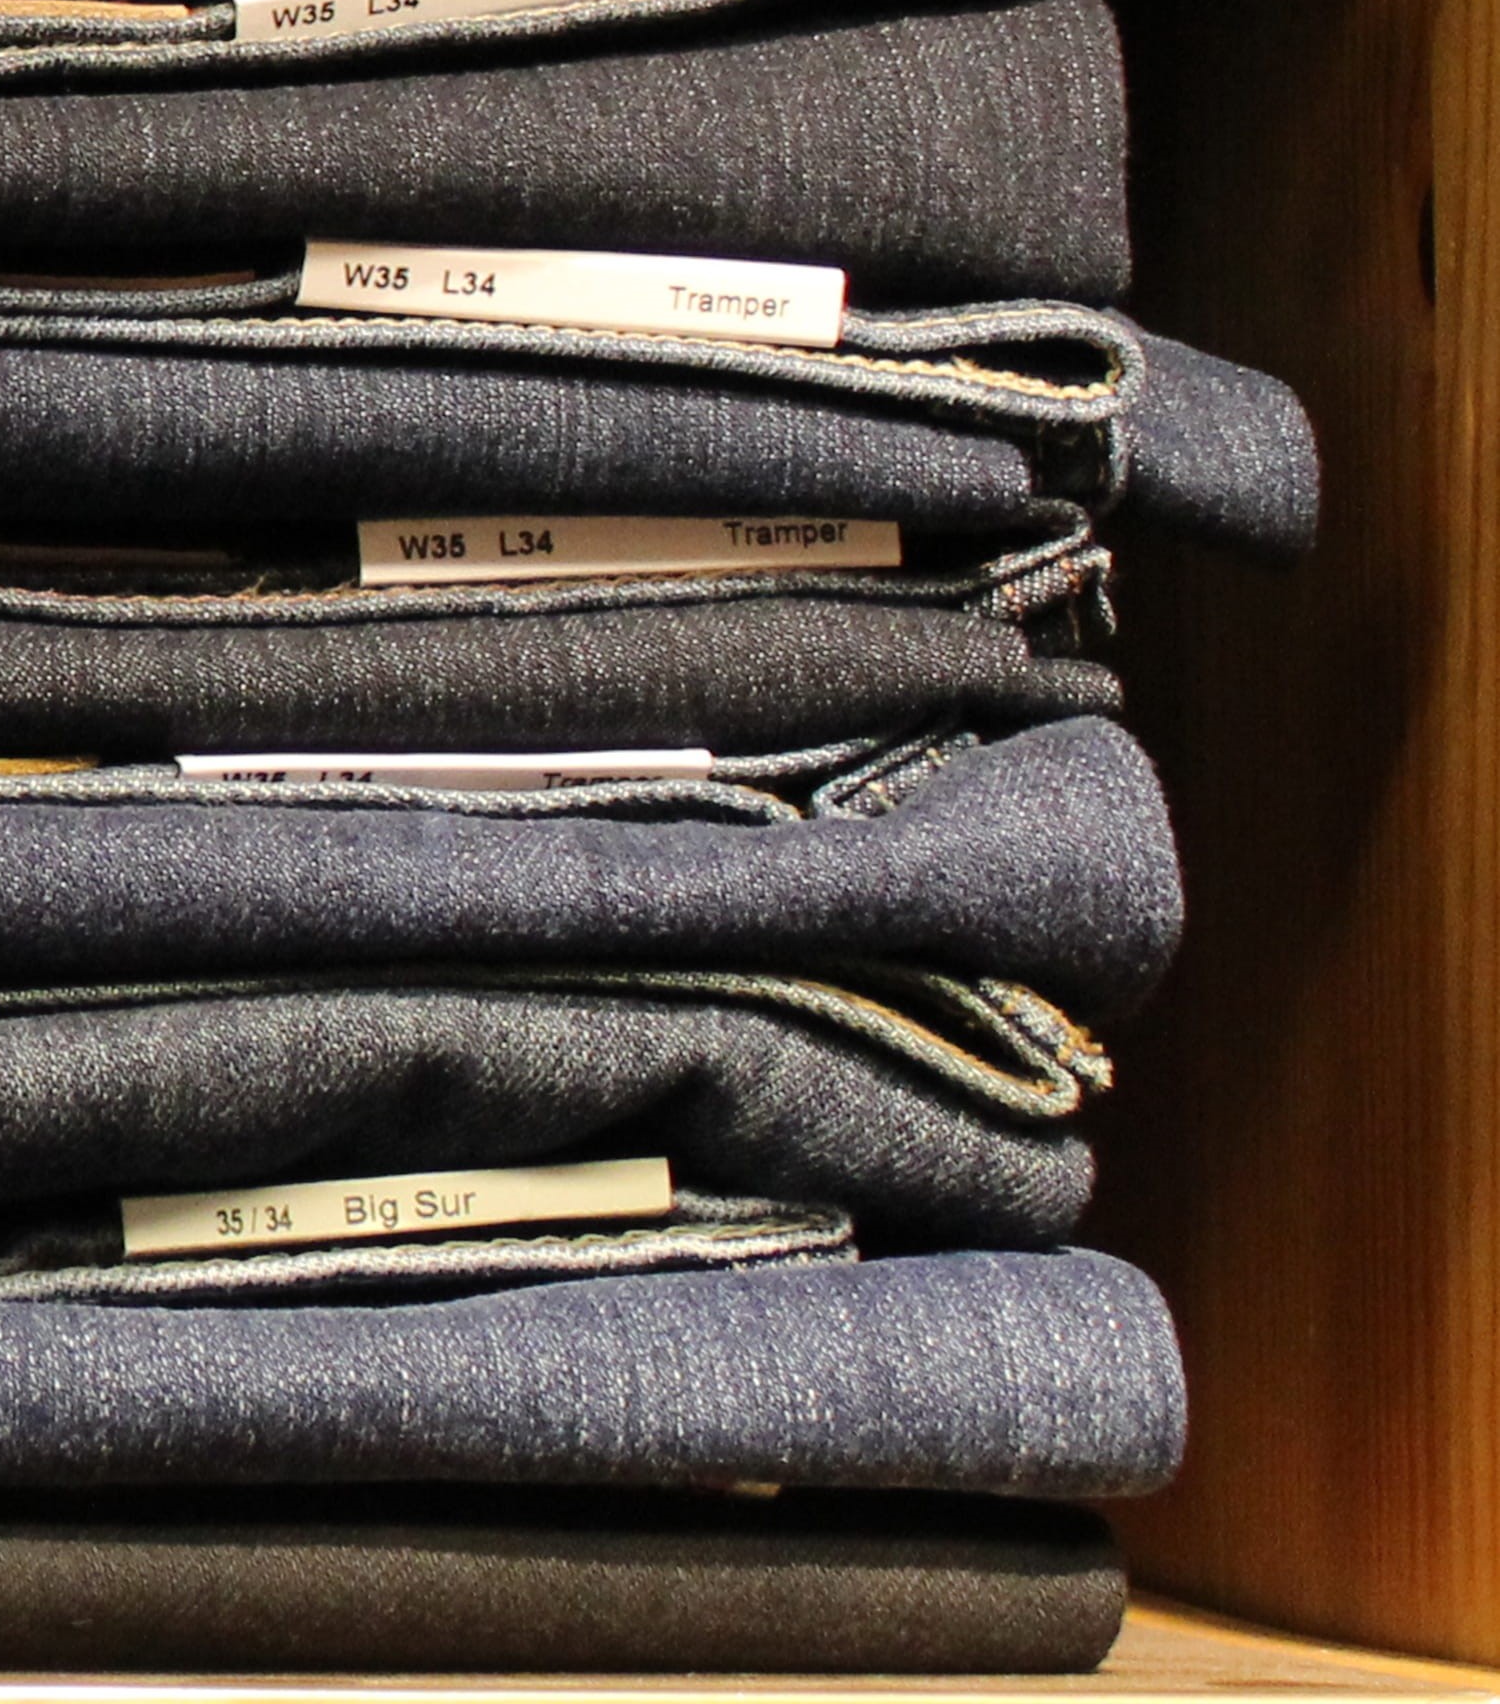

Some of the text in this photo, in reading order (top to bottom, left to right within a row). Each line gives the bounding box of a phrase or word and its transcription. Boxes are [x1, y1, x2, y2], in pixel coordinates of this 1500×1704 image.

[344, 263, 791, 319] W35 L34 Tramper
[399, 519, 849, 561] W35 L34 Tramper
[344, 1195, 399, 1230] Big
[415, 1189, 476, 1219] Sur
